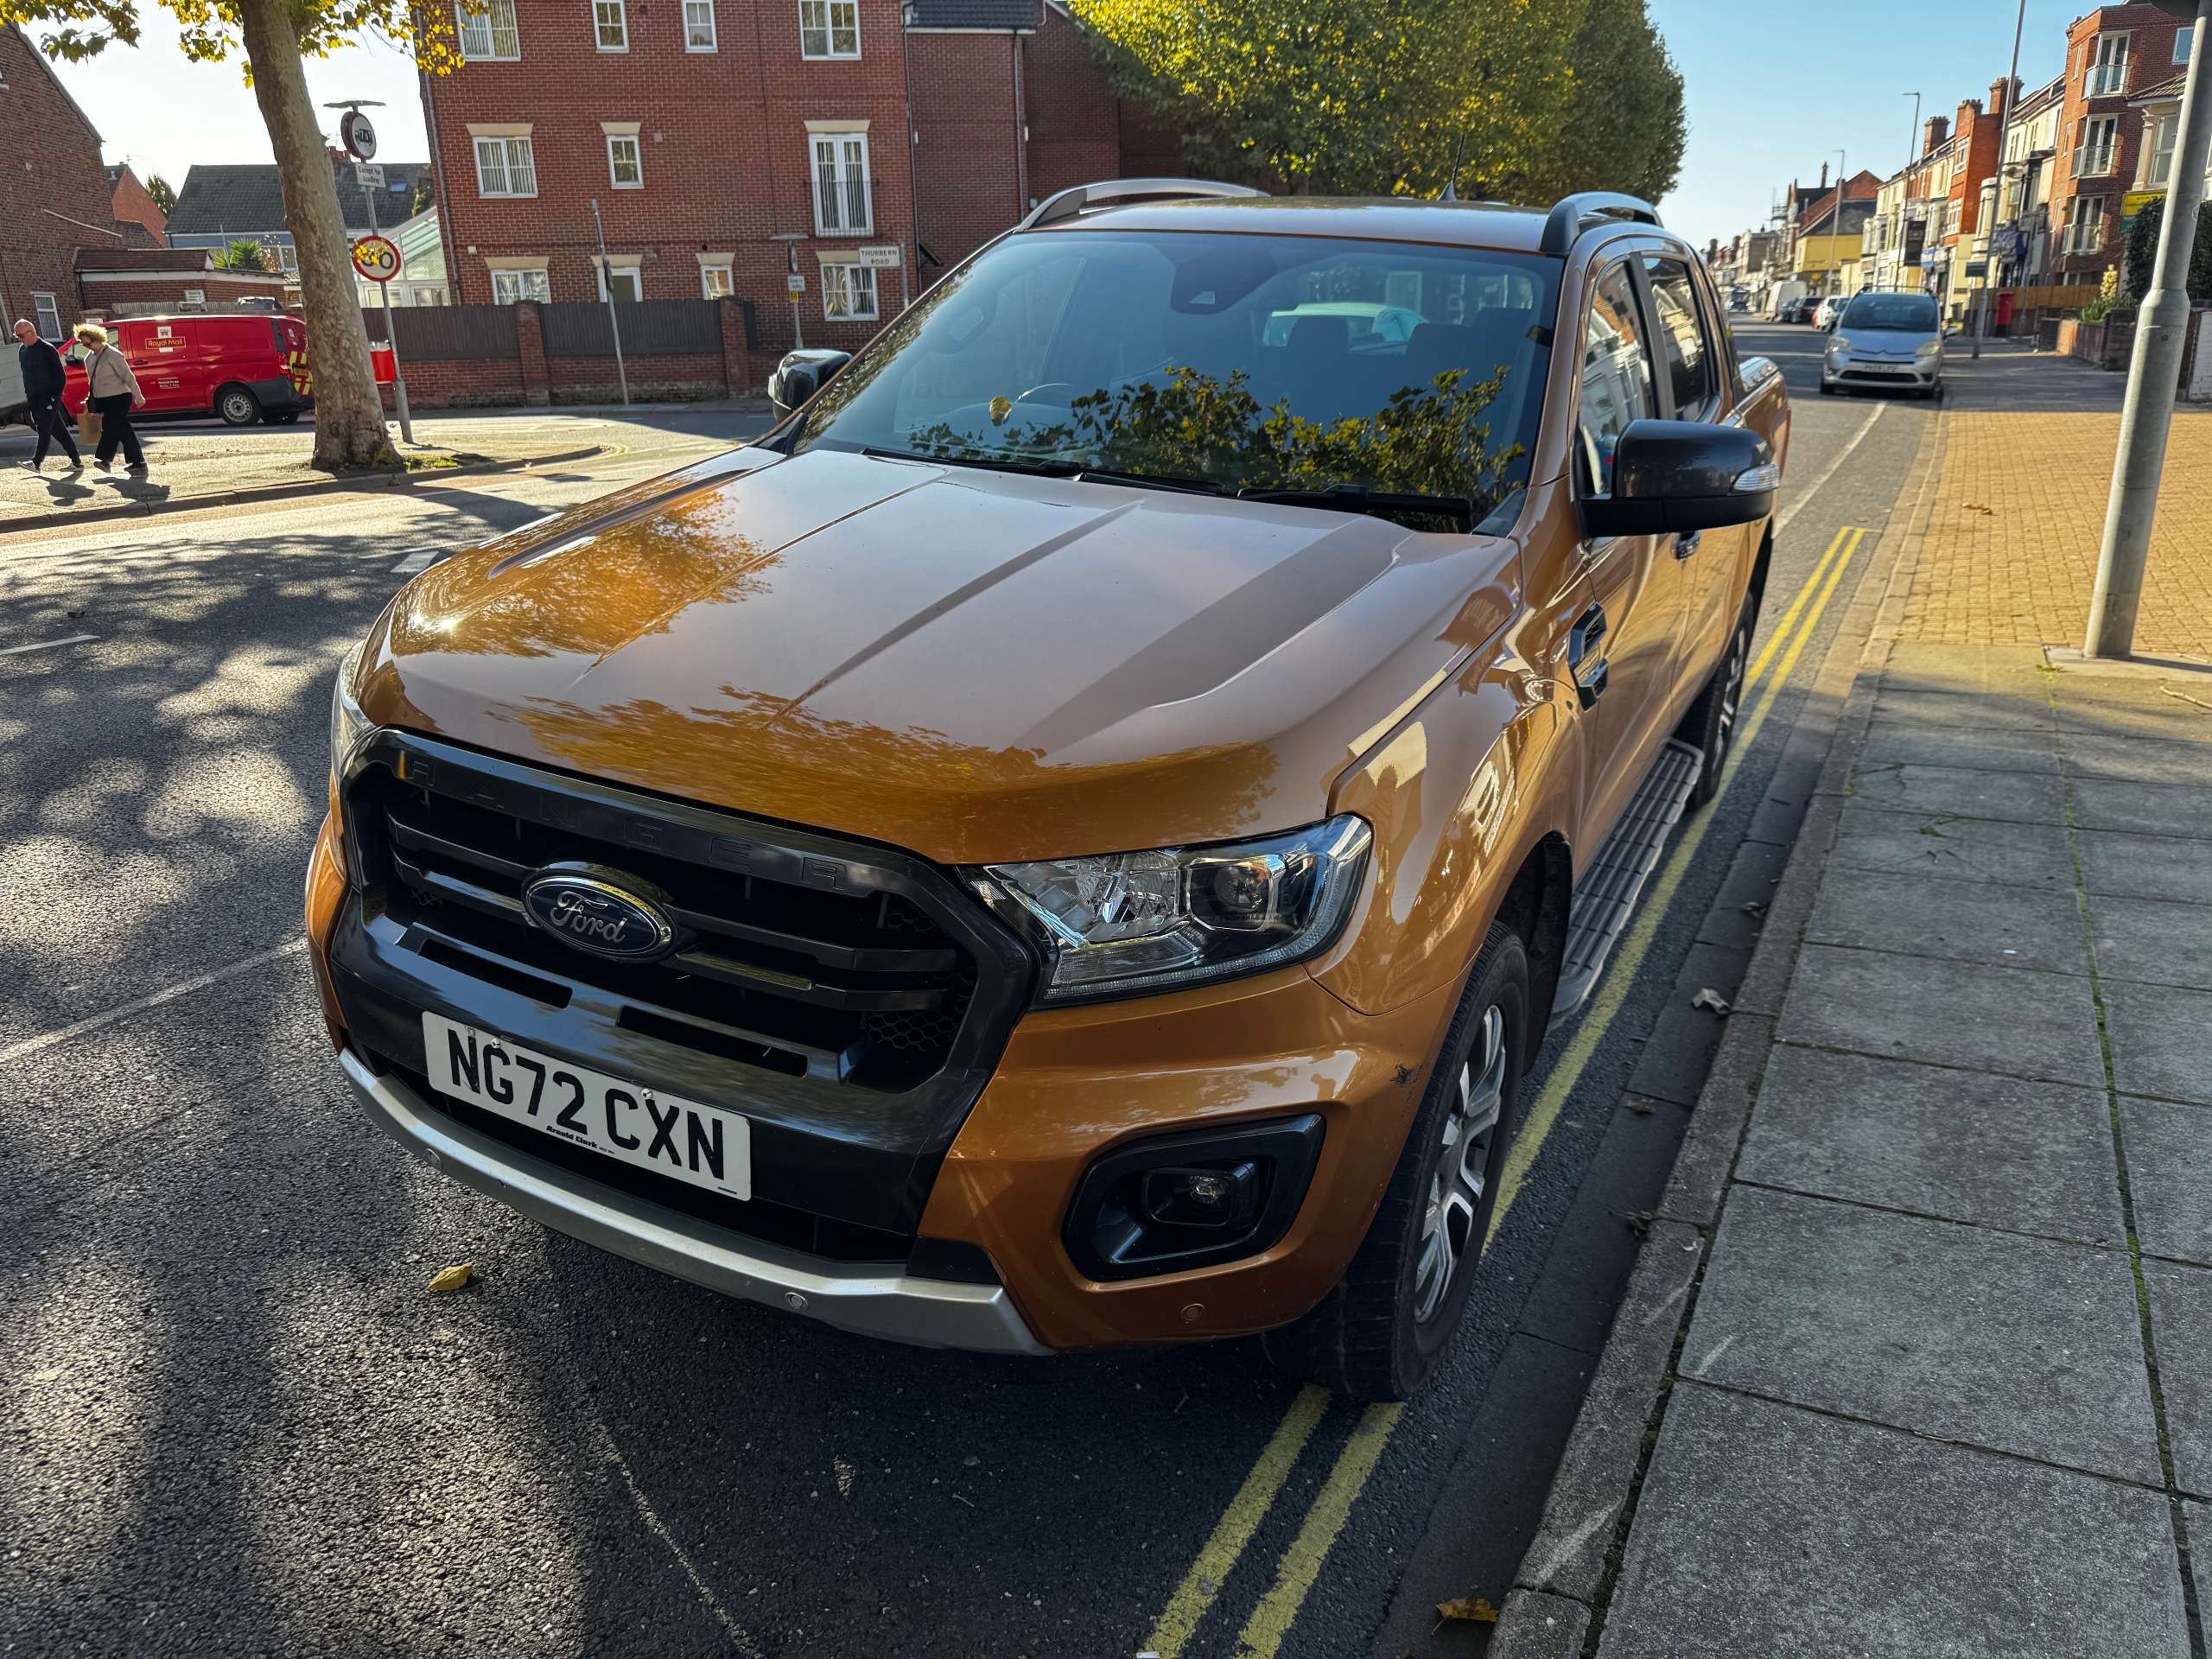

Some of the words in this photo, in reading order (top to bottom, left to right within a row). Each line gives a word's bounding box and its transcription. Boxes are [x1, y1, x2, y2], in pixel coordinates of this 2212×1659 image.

[408, 760, 846, 891] RANGER
[550, 890, 628, 944] Ford
[447, 1027, 588, 1136] NG72
[604, 1087, 725, 1181] CXN
[546, 1125, 575, 1141] Arnold
[575, 1135, 598, 1149] Clark
